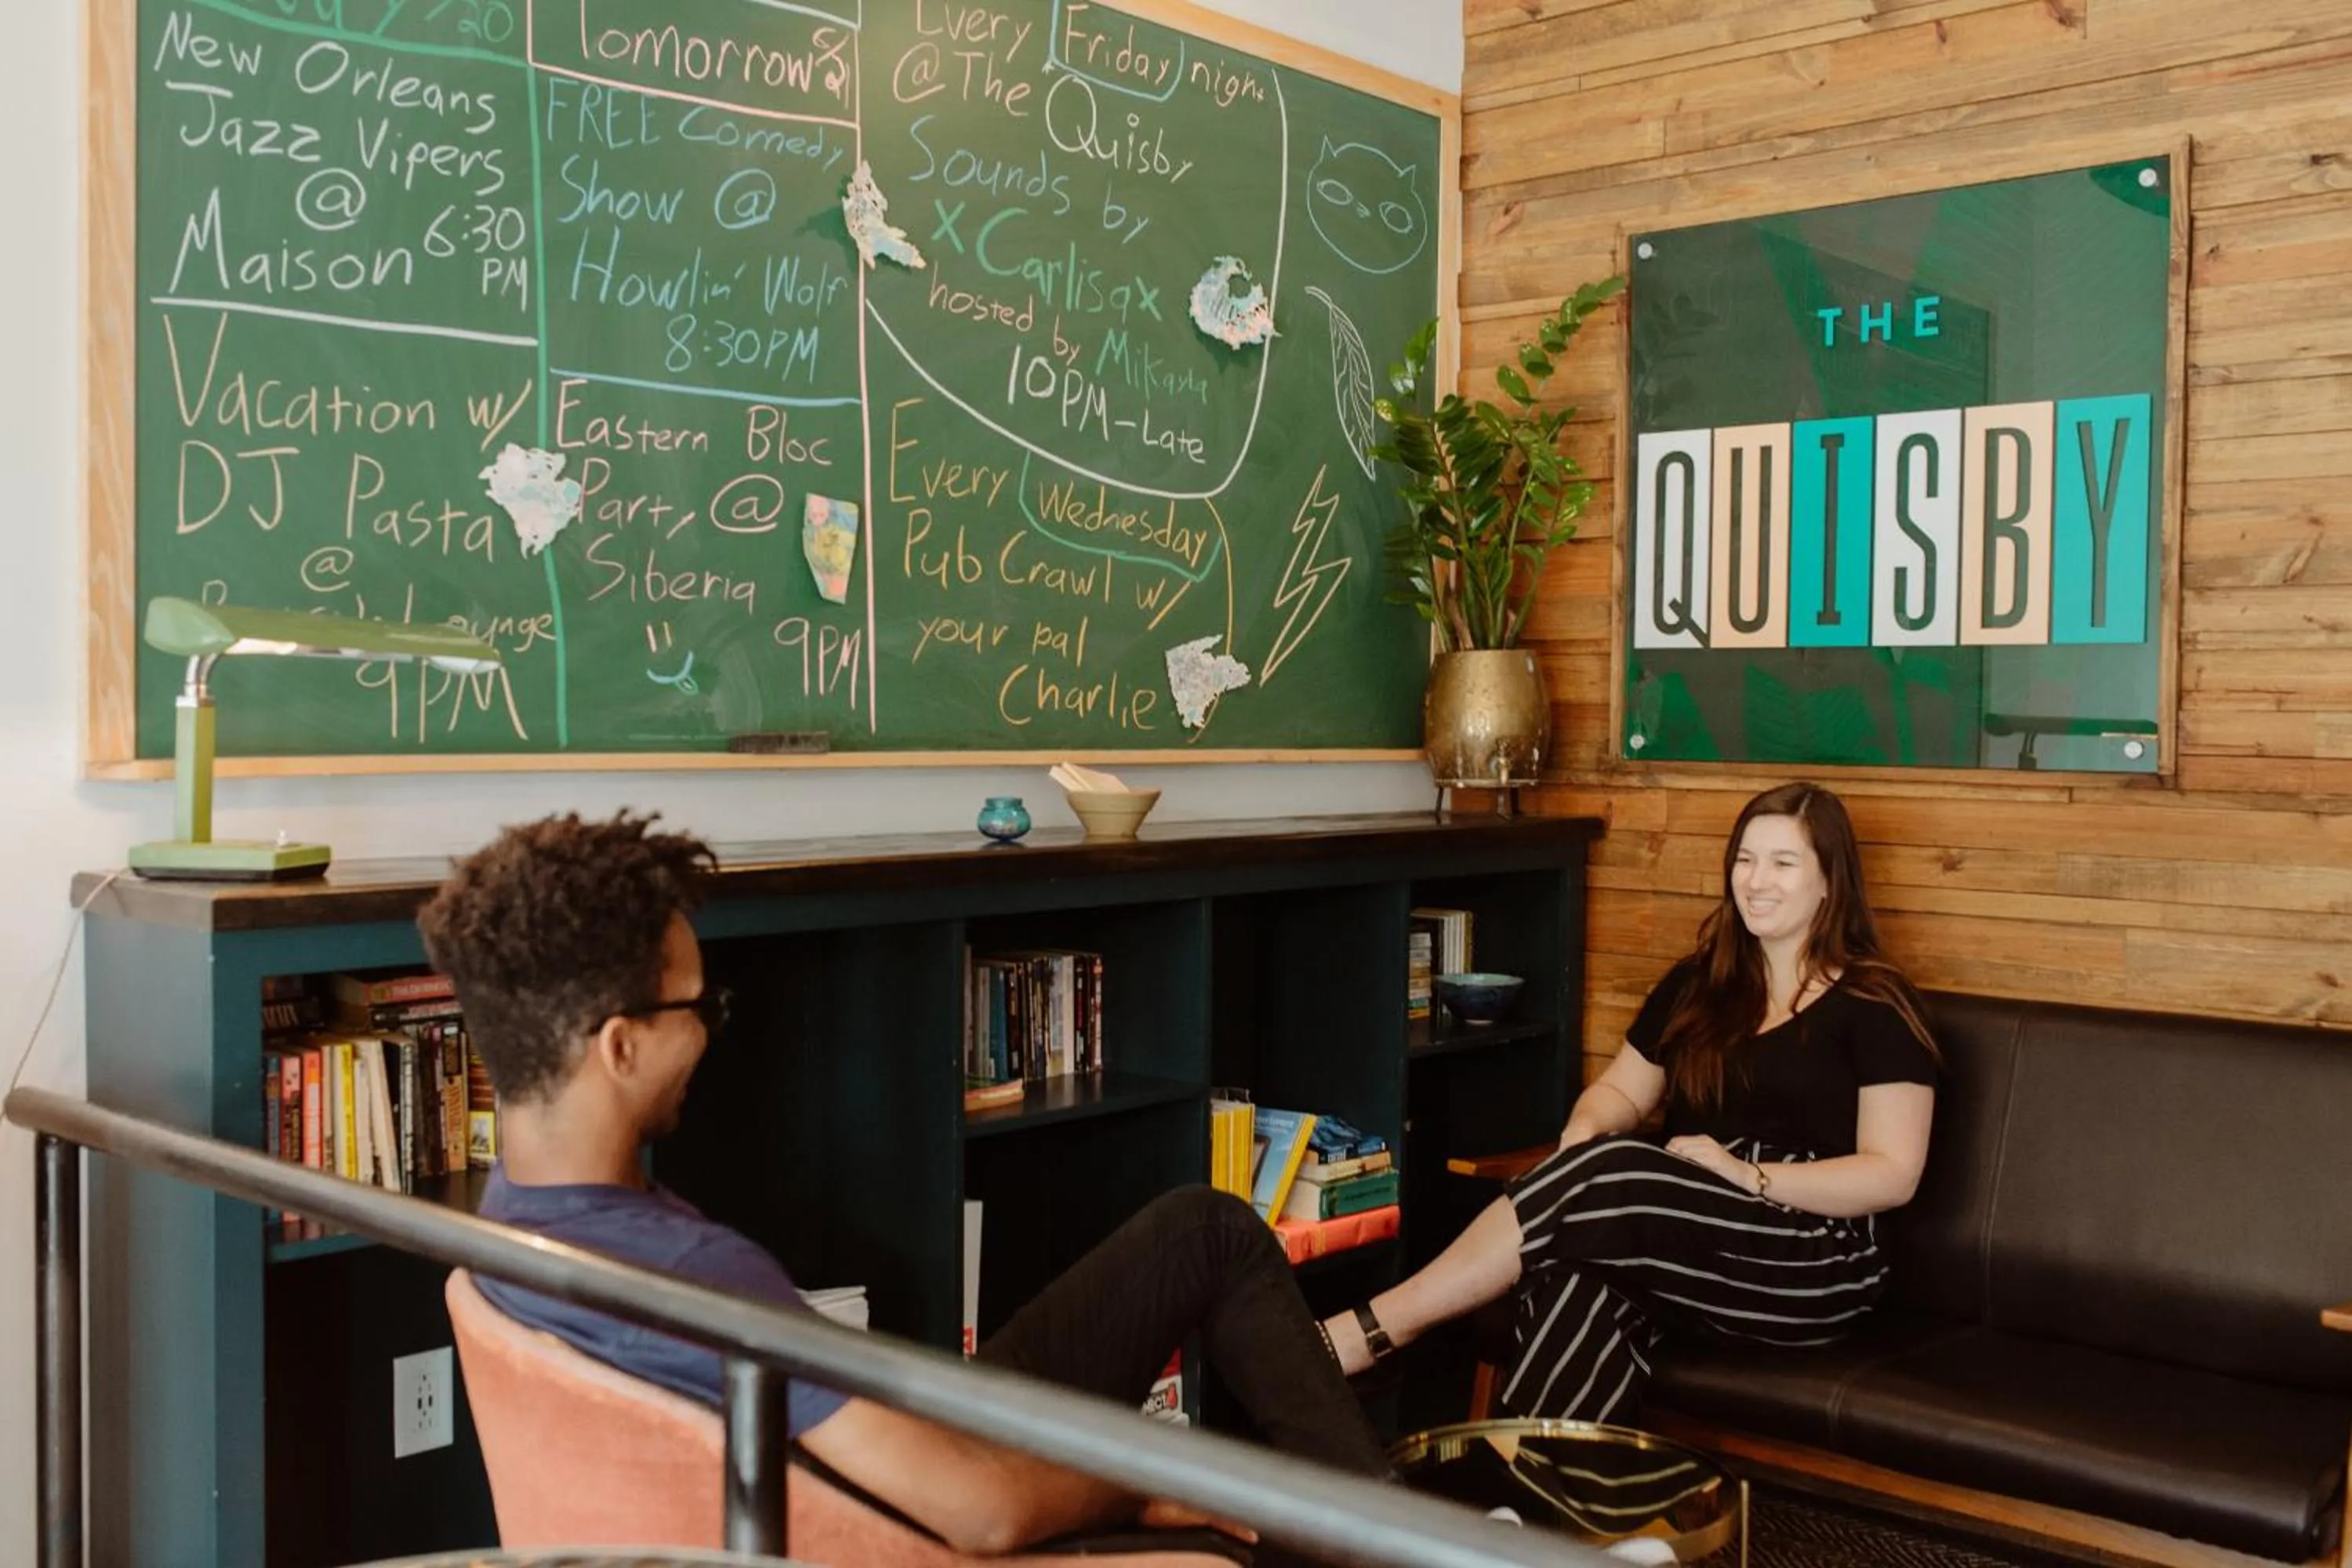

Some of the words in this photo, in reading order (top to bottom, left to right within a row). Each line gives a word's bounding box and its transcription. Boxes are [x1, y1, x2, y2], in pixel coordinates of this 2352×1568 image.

[154, 11, 262, 76] New
[296, 42, 495, 133] Orleans
[1063, 3, 1171, 85] Friday
[165, 81, 321, 162] Jazz
[358, 118, 505, 197] Vipers
[548, 77, 660, 150] FREE
[678, 105, 843, 172] Comedy
[1045, 74, 1193, 183] Quisby
[295, 168, 366, 230] @
[557, 154, 684, 223] Show
[714, 168, 776, 230] @
[908, 114, 1070, 216] Sounds
[1102, 180, 1149, 245] by
[169, 187, 412, 294] Maison
[423, 205, 525, 257] 6:30
[481, 258, 528, 313] PM
[571, 225, 746, 311] Howlin'
[764, 256, 848, 315] Wolf
[664, 313, 818, 384] 8:30PM
[928, 259, 1033, 332] hosted
[1052, 314, 1081, 367] by
[1817, 295, 1940, 347] THE
[163, 312, 434, 436] Vacation
[468, 379, 532, 452] w/
[556, 379, 708, 455] Eastern
[746, 404, 833, 465] Bloc
[176, 439, 299, 535] DJ
[346, 453, 494, 563] Pasta
[710, 474, 784, 533] @
[889, 397, 1009, 508] Every
[1039, 480, 1208, 569] Wednesday
[300, 546, 354, 592] @
[586, 533, 757, 615] Siberia
[903, 508, 982, 590] Pub
[1000, 530, 1112, 603] Crawl
[1136, 579, 1192, 630] w/
[1651, 416, 2134, 649] QUISBY
[773, 616, 862, 710] 9PM
[911, 615, 1009, 665] your
[1033, 615, 1088, 667] pal
[999, 663, 1158, 731] Charlie
